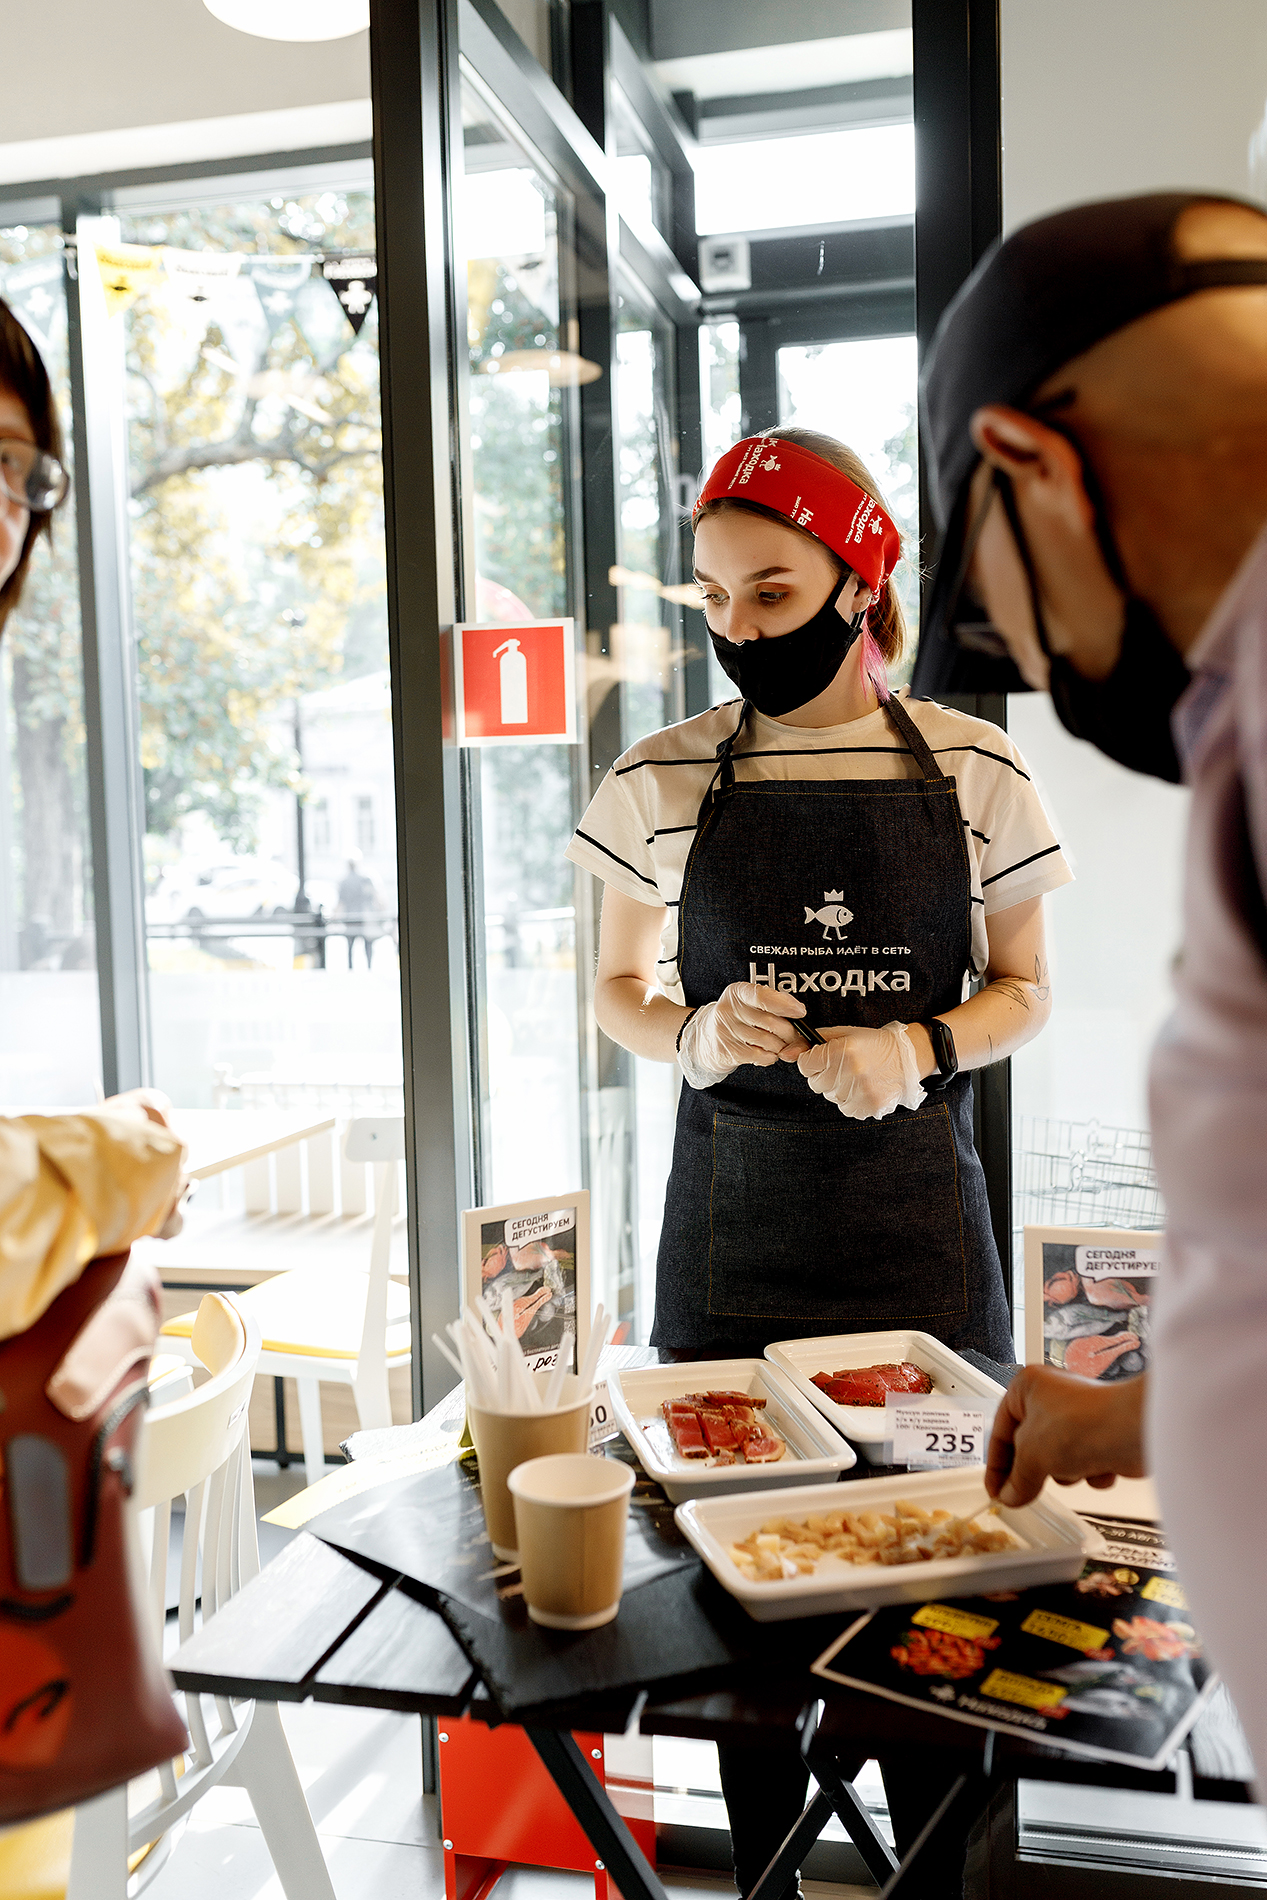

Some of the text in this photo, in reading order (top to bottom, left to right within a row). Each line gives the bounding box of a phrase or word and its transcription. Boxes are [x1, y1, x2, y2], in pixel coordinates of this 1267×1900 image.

[853, 497, 878, 544] аходка
[750, 945, 912, 956] СВЕЖАЯ РЫБА ИДЁТ В СЕТЬ
[749, 961, 911, 998] Находка
[511, 1213, 549, 1231] СЕГОДНЯ
[511, 1217, 570, 1242] ДЕГУСТИРУЕМ
[1085, 1250, 1136, 1260] СЕГОДНЯ
[1085, 1261, 1161, 1272] ДЕГУСТИРУЕ
[925, 1433, 975, 1453] 235
